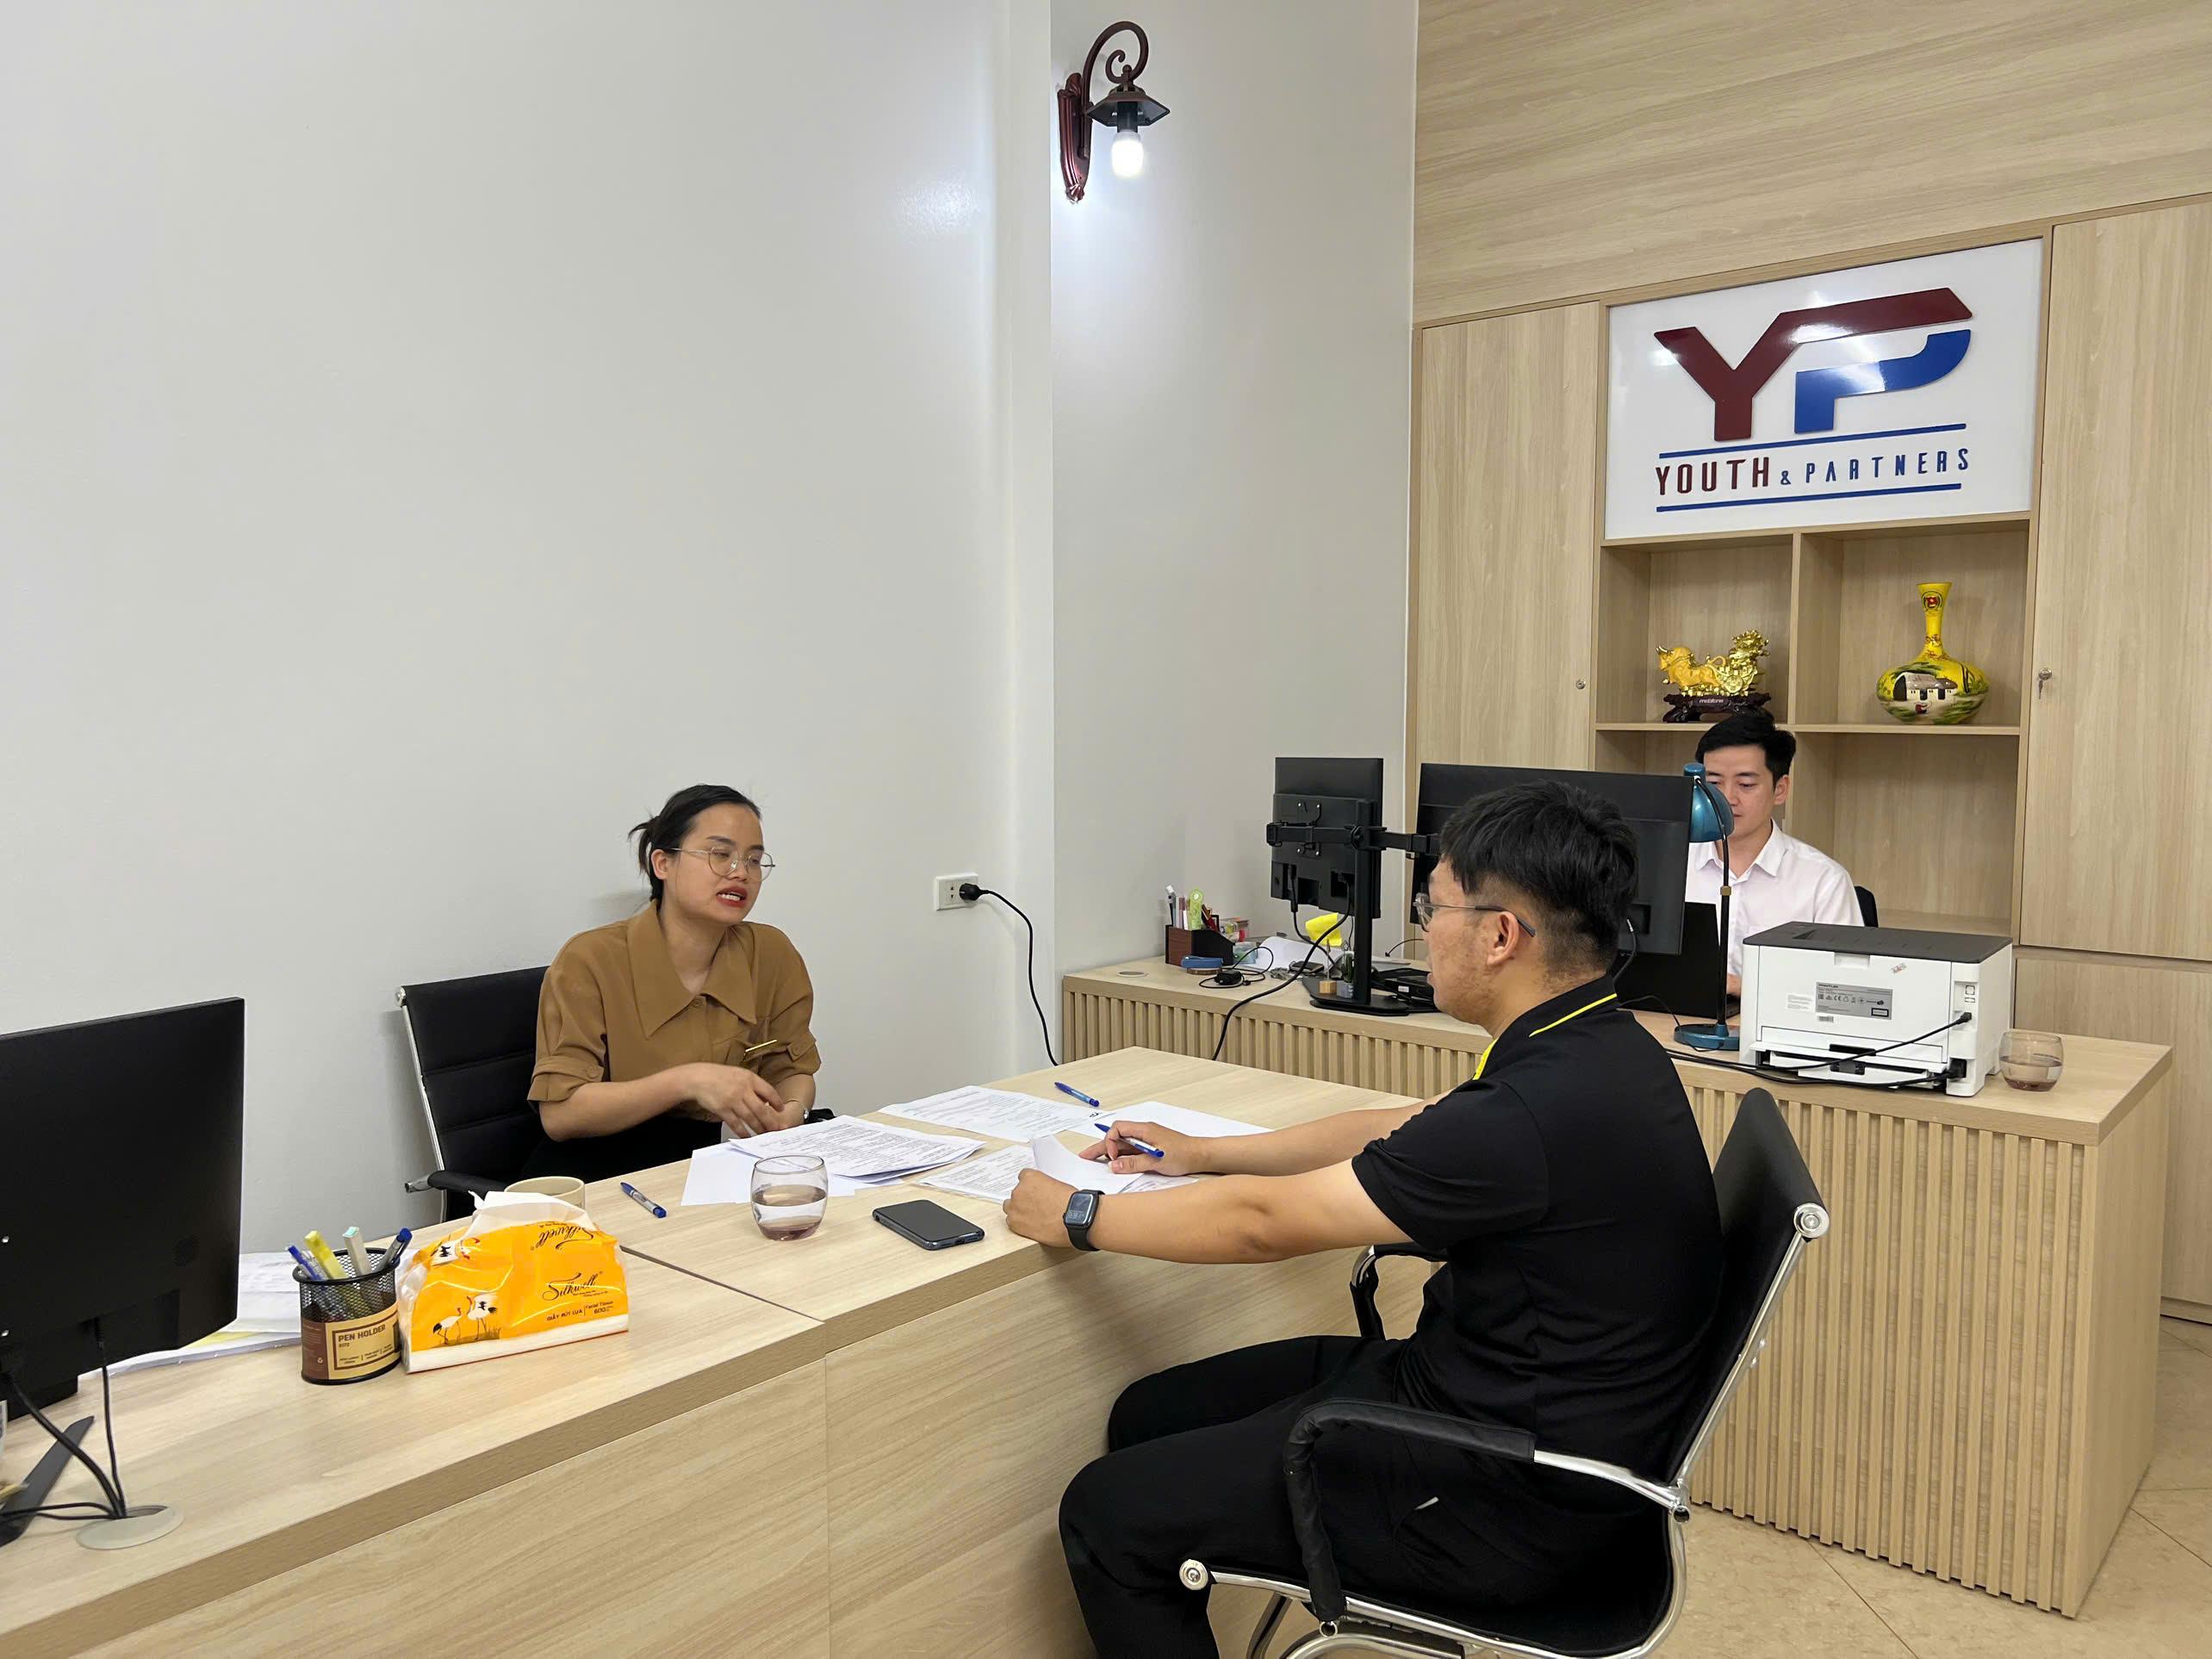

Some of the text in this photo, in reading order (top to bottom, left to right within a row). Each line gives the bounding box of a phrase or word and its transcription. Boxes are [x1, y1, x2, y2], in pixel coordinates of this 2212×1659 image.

[1654, 287, 1973, 442] YP
[1655, 448, 1969, 495] YOUTH & PARTNERS
[542, 1272, 600, 1301] Silkwell
[338, 1325, 385, 1342] PEN HOLDER
